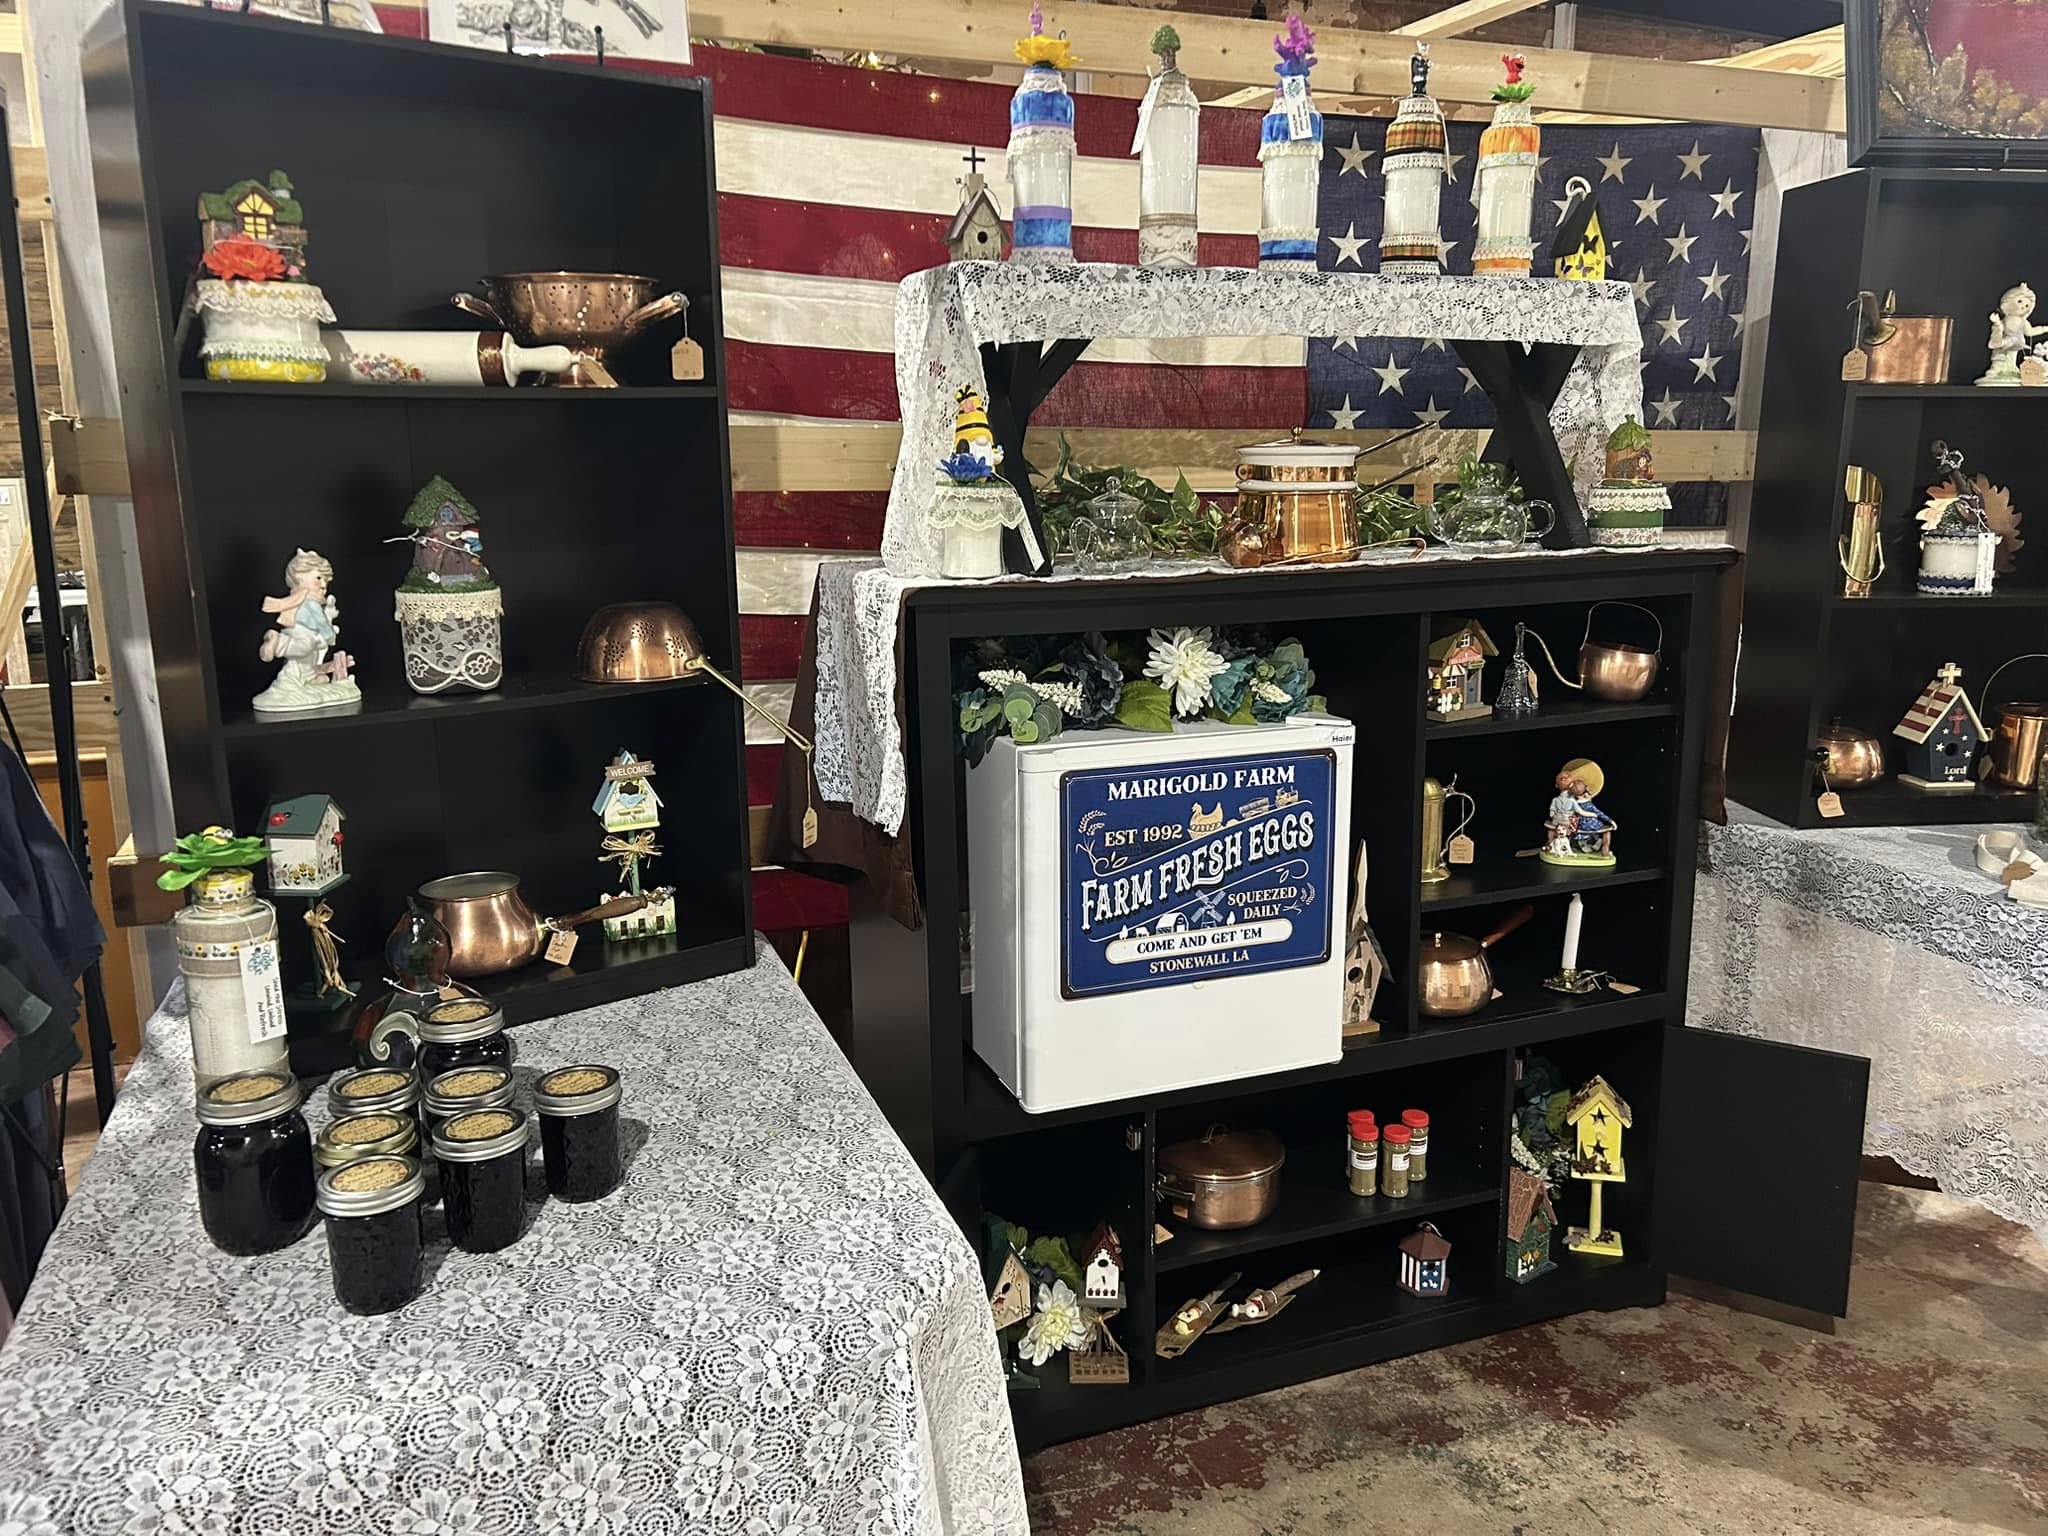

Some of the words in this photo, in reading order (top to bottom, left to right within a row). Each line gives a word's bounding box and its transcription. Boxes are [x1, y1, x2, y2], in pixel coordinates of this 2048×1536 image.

[1332, 735, 1353, 743] Haier
[610, 764, 650, 777] WELCOME
[1944, 766, 1967, 775] Lord
[1107, 772, 1228, 801] MARIGOLD
[1234, 765, 1296, 789] FARM
[1104, 830, 1138, 847] EST
[1143, 824, 1183, 843] 1992
[1081, 868, 1154, 931] FARM
[1159, 830, 1243, 900] FRESH
[1248, 811, 1315, 862] EGGS
[1227, 886, 1298, 907] SQUEEZED
[1243, 904, 1282, 920] DAILY
[1137, 938, 1176, 955] COME
[1179, 933, 1207, 949] AND
[1211, 930, 1237, 945] GET
[1240, 927, 1263, 941] 'EM
[1150, 952, 1230, 974] STONEWALL
[1233, 949, 1250, 962] LA
